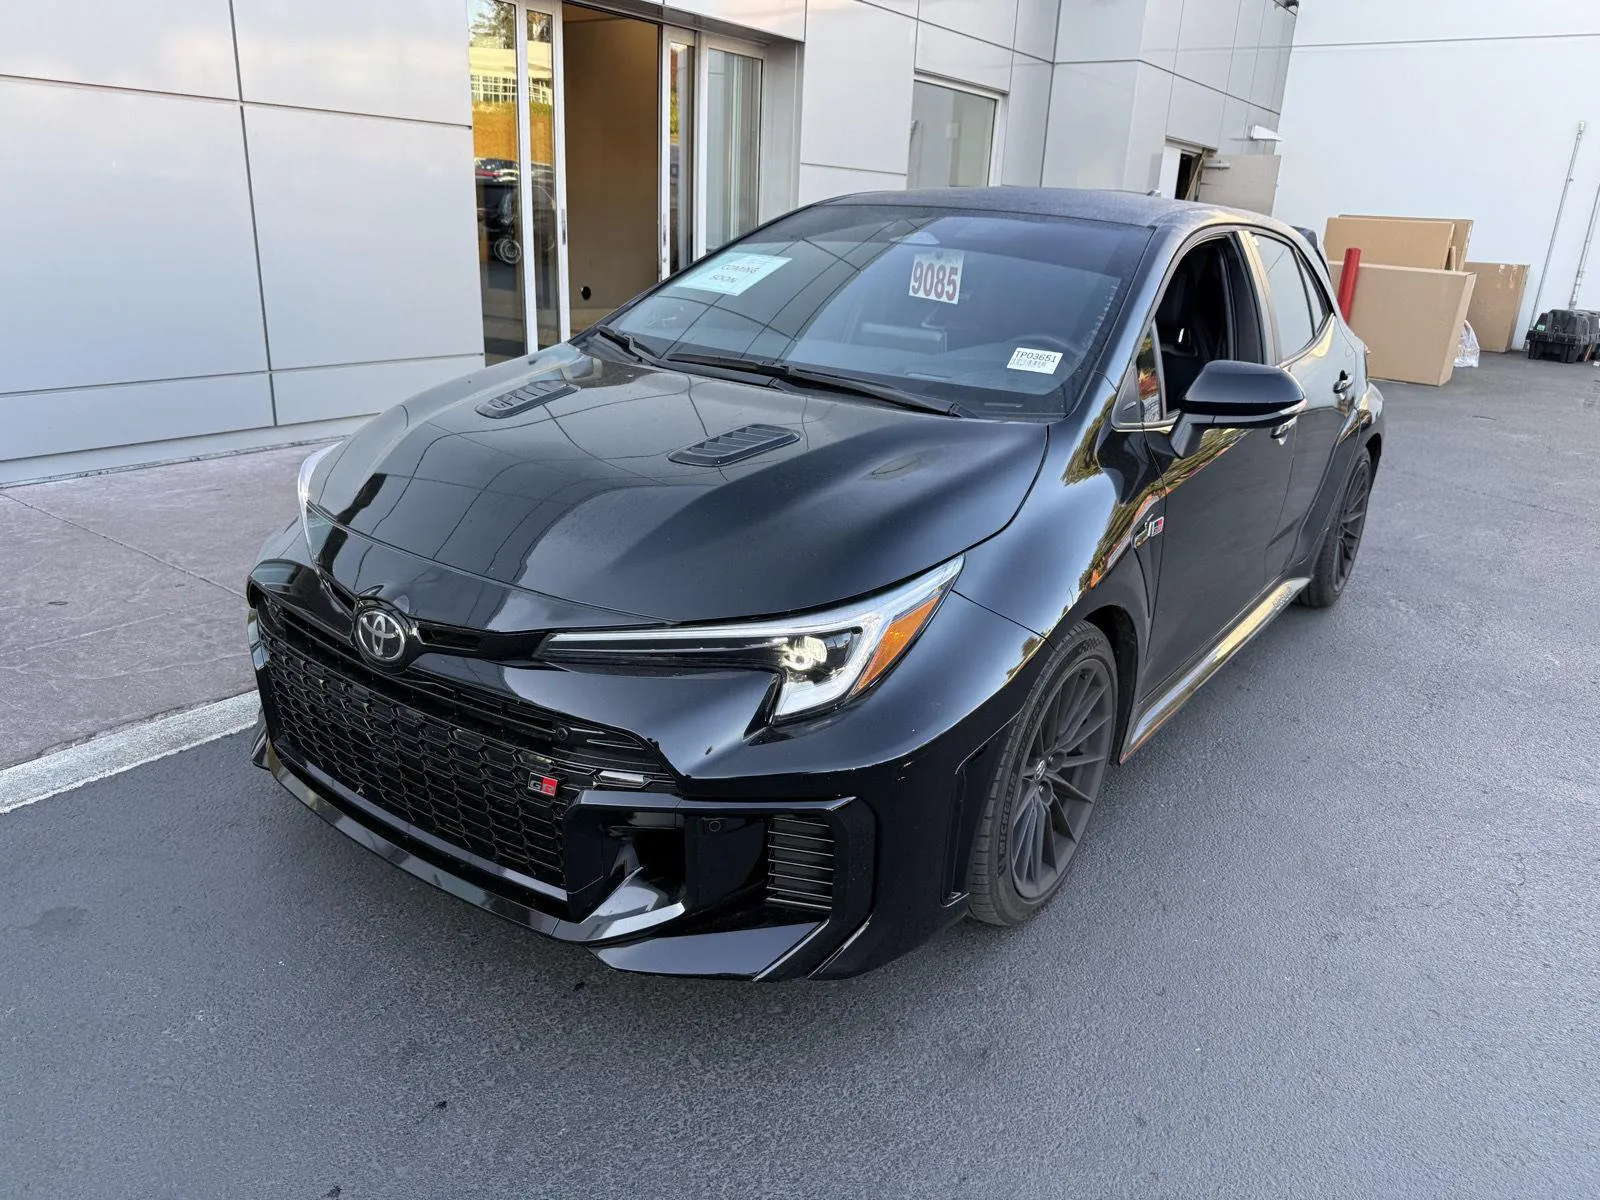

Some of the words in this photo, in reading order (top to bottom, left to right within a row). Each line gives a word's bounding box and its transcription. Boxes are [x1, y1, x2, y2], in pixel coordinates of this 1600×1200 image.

[720, 264, 760, 275] COMING
[708, 274, 737, 284] SOON
[911, 261, 959, 301] 9085
[1016, 350, 1057, 363] TP03651
[529, 779, 556, 795] GR
[999, 772, 1018, 855] MICHELIN
